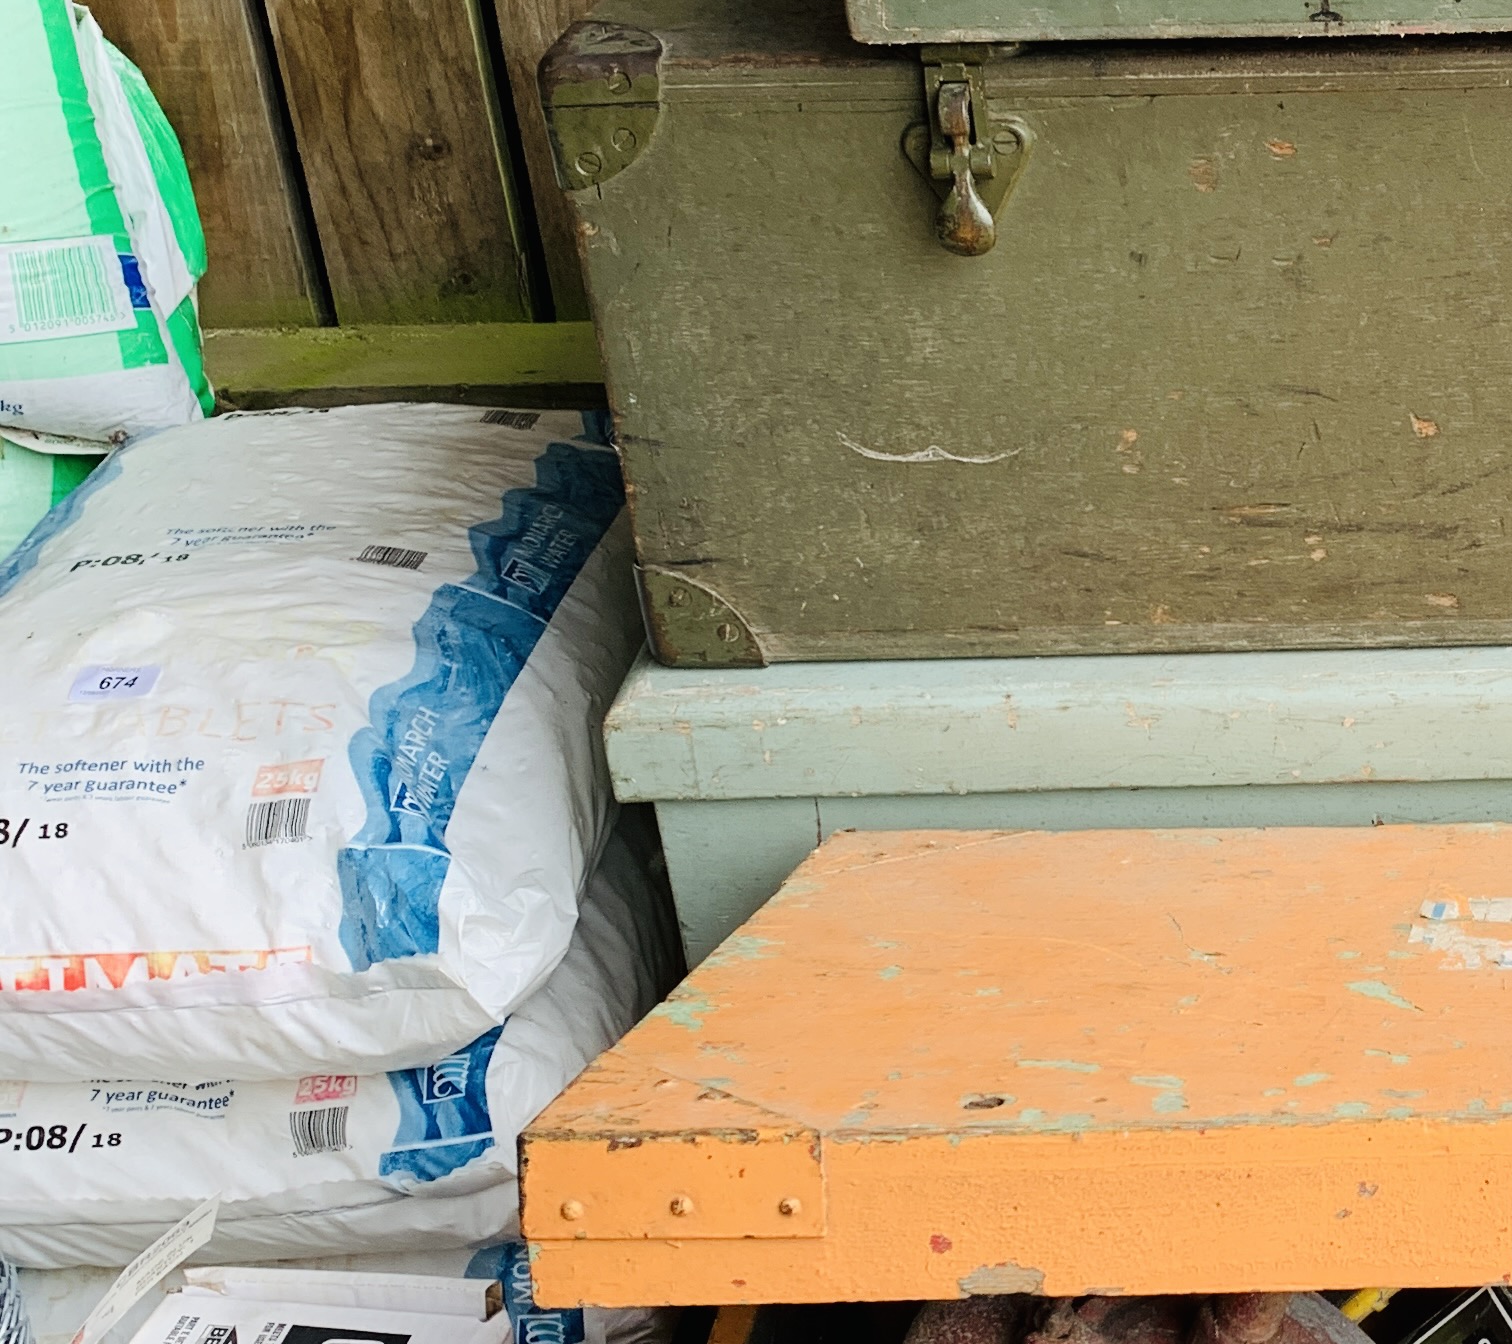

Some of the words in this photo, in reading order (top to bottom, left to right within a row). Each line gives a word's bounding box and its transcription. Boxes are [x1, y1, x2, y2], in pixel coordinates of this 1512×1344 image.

[540, 529, 579, 573] WATER
[99, 676, 139, 690] 674
[18, 762, 49, 775] The
[54, 759, 125, 774] softener
[133, 758, 172, 774] with
[176, 757, 205, 772] the
[27, 781, 38, 791] 7
[42, 780, 81, 795] year
[256, 769, 319, 792] 25kg
[38, 823, 69, 839] 18
[299, 1075, 357, 1095] 25kg
[90, 1089, 100, 1101] 7
[105, 1090, 142, 1104] year
[91, 1133, 122, 1148] 18
